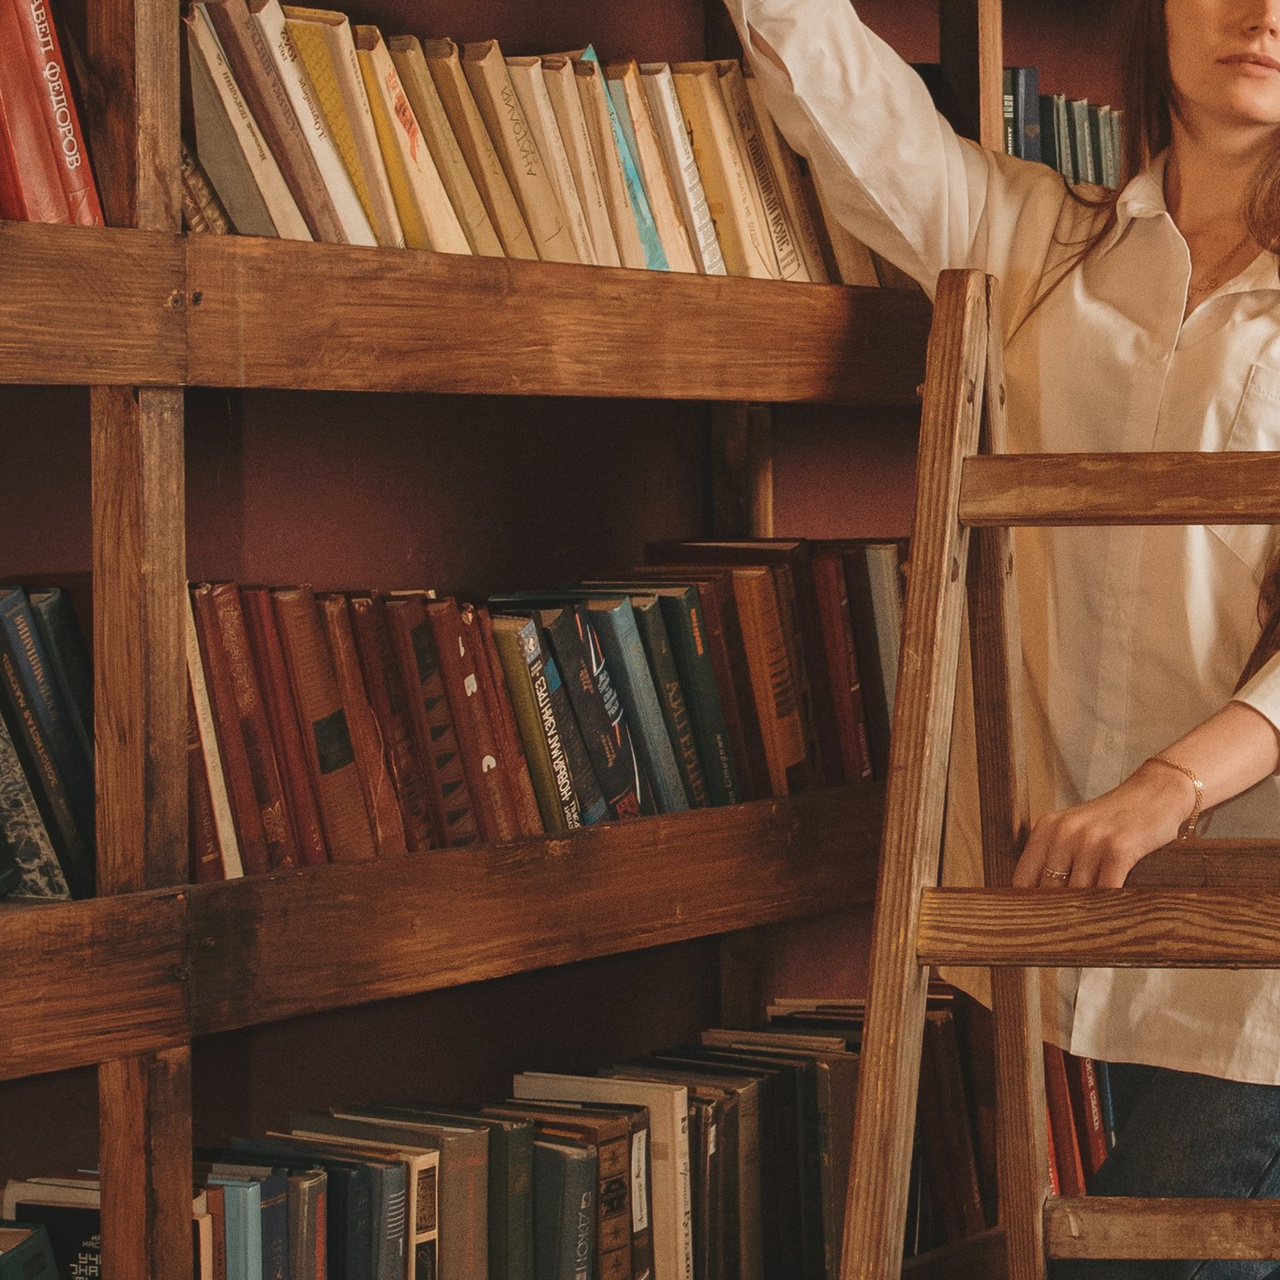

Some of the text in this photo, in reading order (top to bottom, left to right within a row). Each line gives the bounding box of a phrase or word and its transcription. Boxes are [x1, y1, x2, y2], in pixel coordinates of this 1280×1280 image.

[41, 60, 82, 172] ФЕДОРОВ
[221, 70, 248, 120] ПОГОДИН
[532, 674, 550, 706] ГРЕЗ
[540, 704, 562, 757] МАГАЗИН
[551, 754, 574, 801] НОВЫЙ
[575, 1212, 589, 1271] ДЖОН
